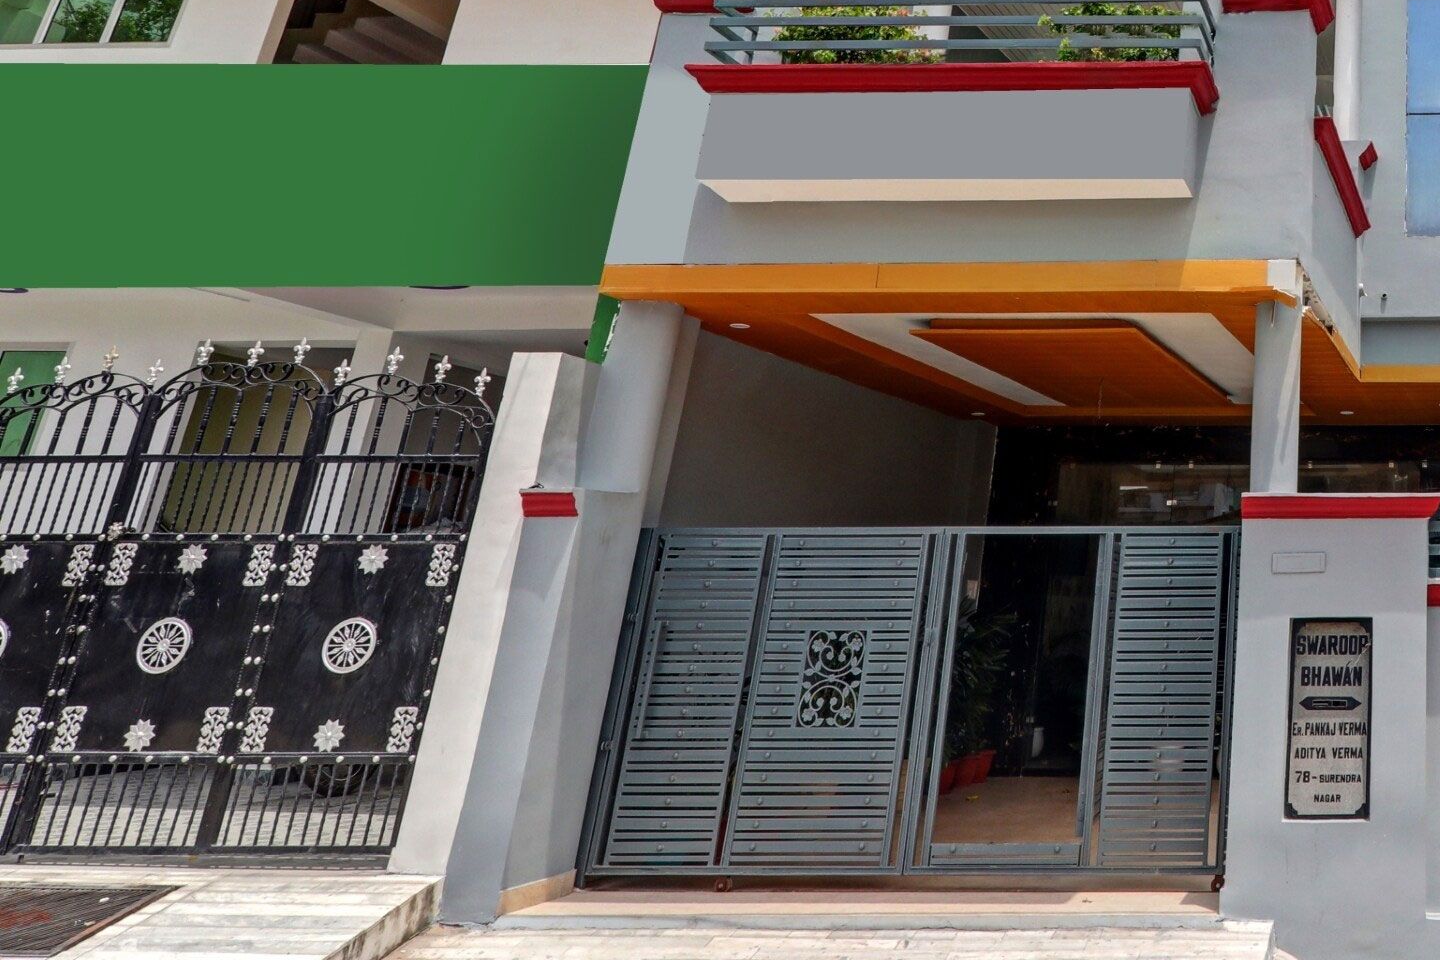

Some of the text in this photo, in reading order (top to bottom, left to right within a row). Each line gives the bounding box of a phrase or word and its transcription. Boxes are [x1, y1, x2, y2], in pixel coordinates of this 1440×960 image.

[1296, 634, 1369, 656] SWAROOP
[1300, 666, 1363, 687] BHAWAN
[1304, 721, 1337, 737] PANKAJ
[1338, 721, 1368, 737] VERMA
[1294, 747, 1364, 760] ADITYA VERMA
[1313, 793, 1342, 803] NAGAR
